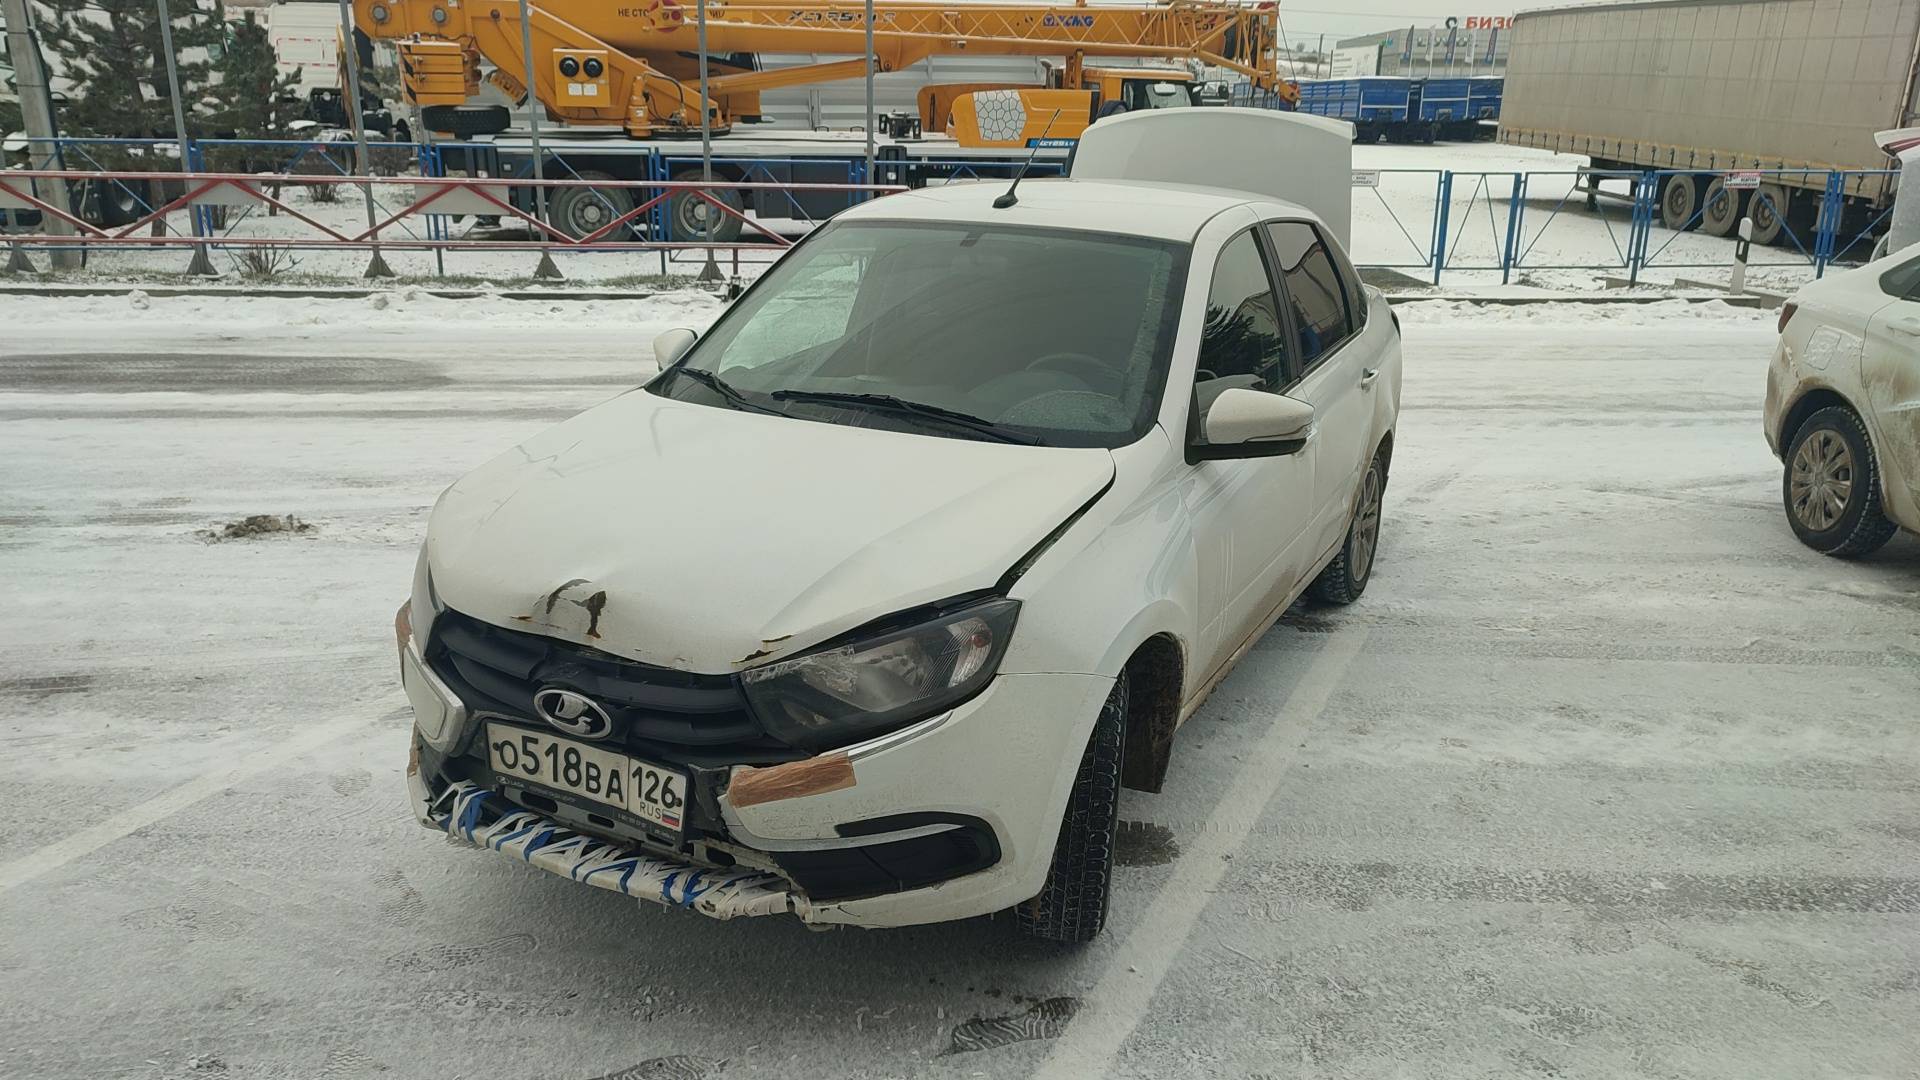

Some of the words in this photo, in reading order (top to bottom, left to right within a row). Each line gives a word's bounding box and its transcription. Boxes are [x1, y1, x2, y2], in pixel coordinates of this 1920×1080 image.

[618, 8, 630, 17] НЕ
[632, 766, 678, 809] 126
[639, 802, 661, 820] RUS
